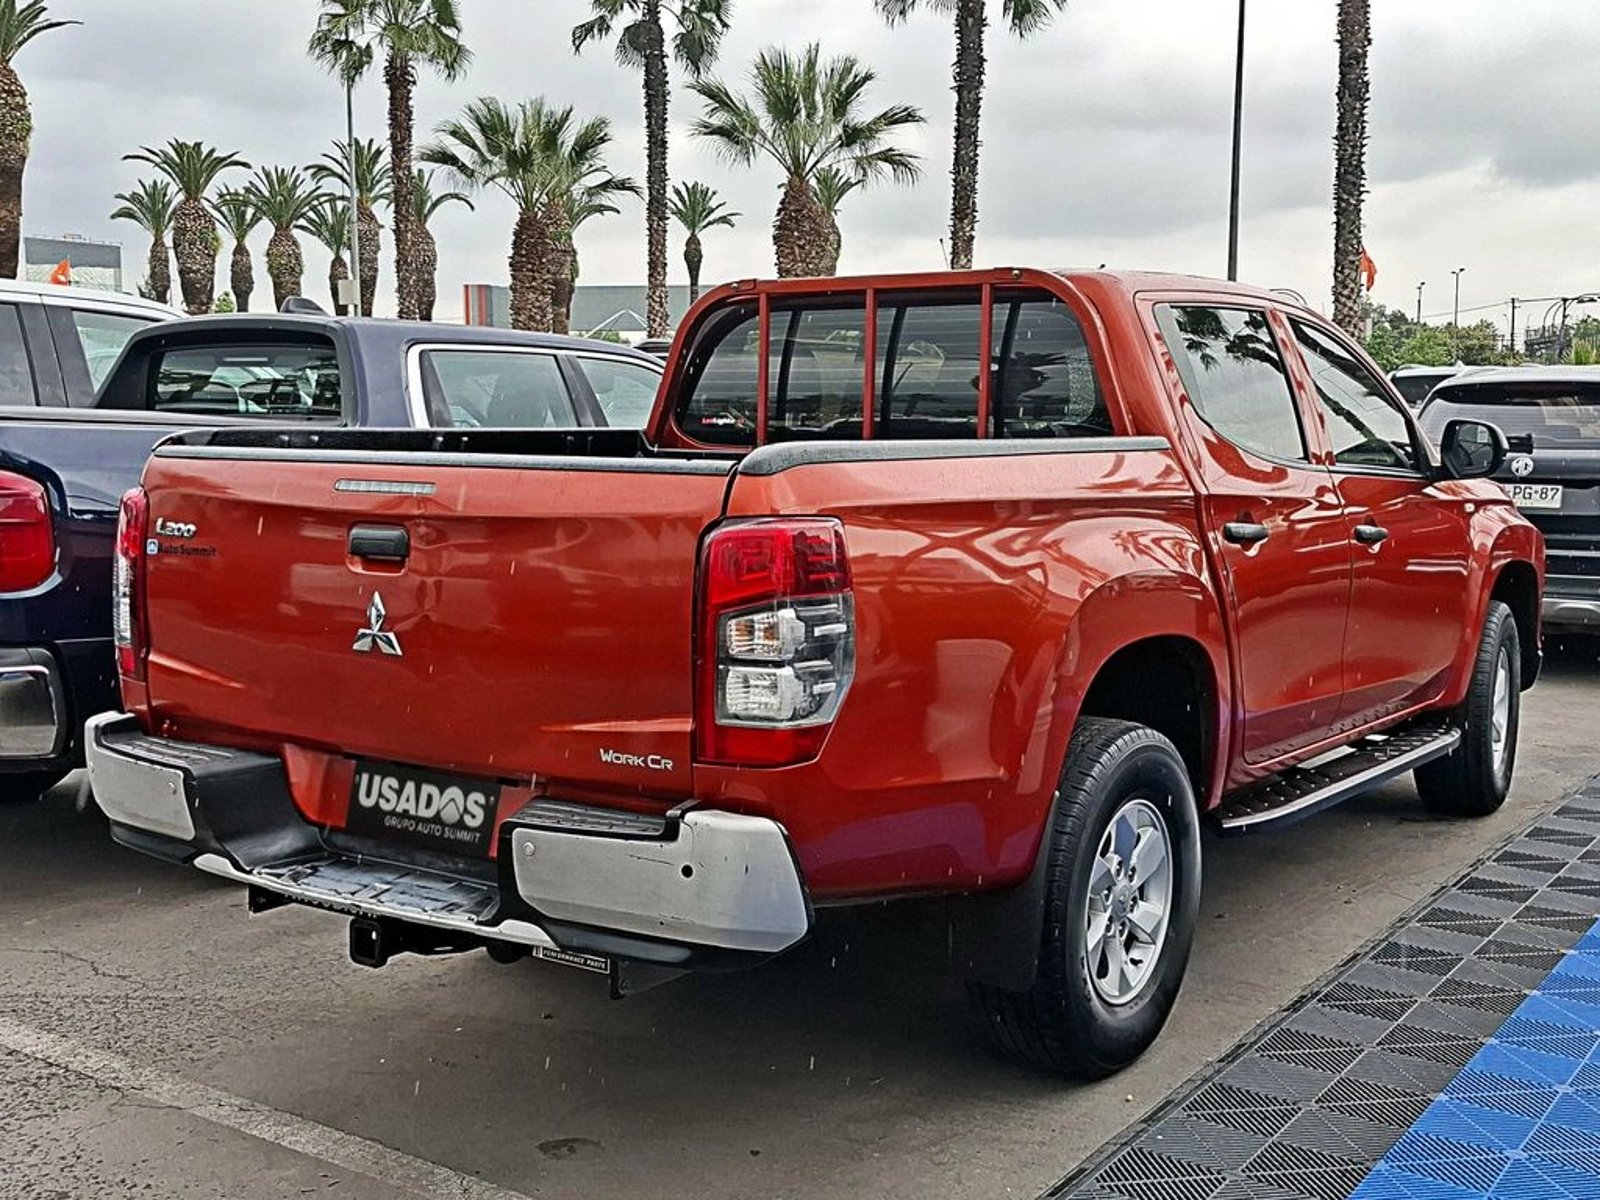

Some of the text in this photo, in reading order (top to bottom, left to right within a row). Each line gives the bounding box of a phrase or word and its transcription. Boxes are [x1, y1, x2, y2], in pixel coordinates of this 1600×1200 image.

[358, 772, 486, 828] USADOS
[384, 815, 481, 844] GRUPO AUTO SUMMIT
